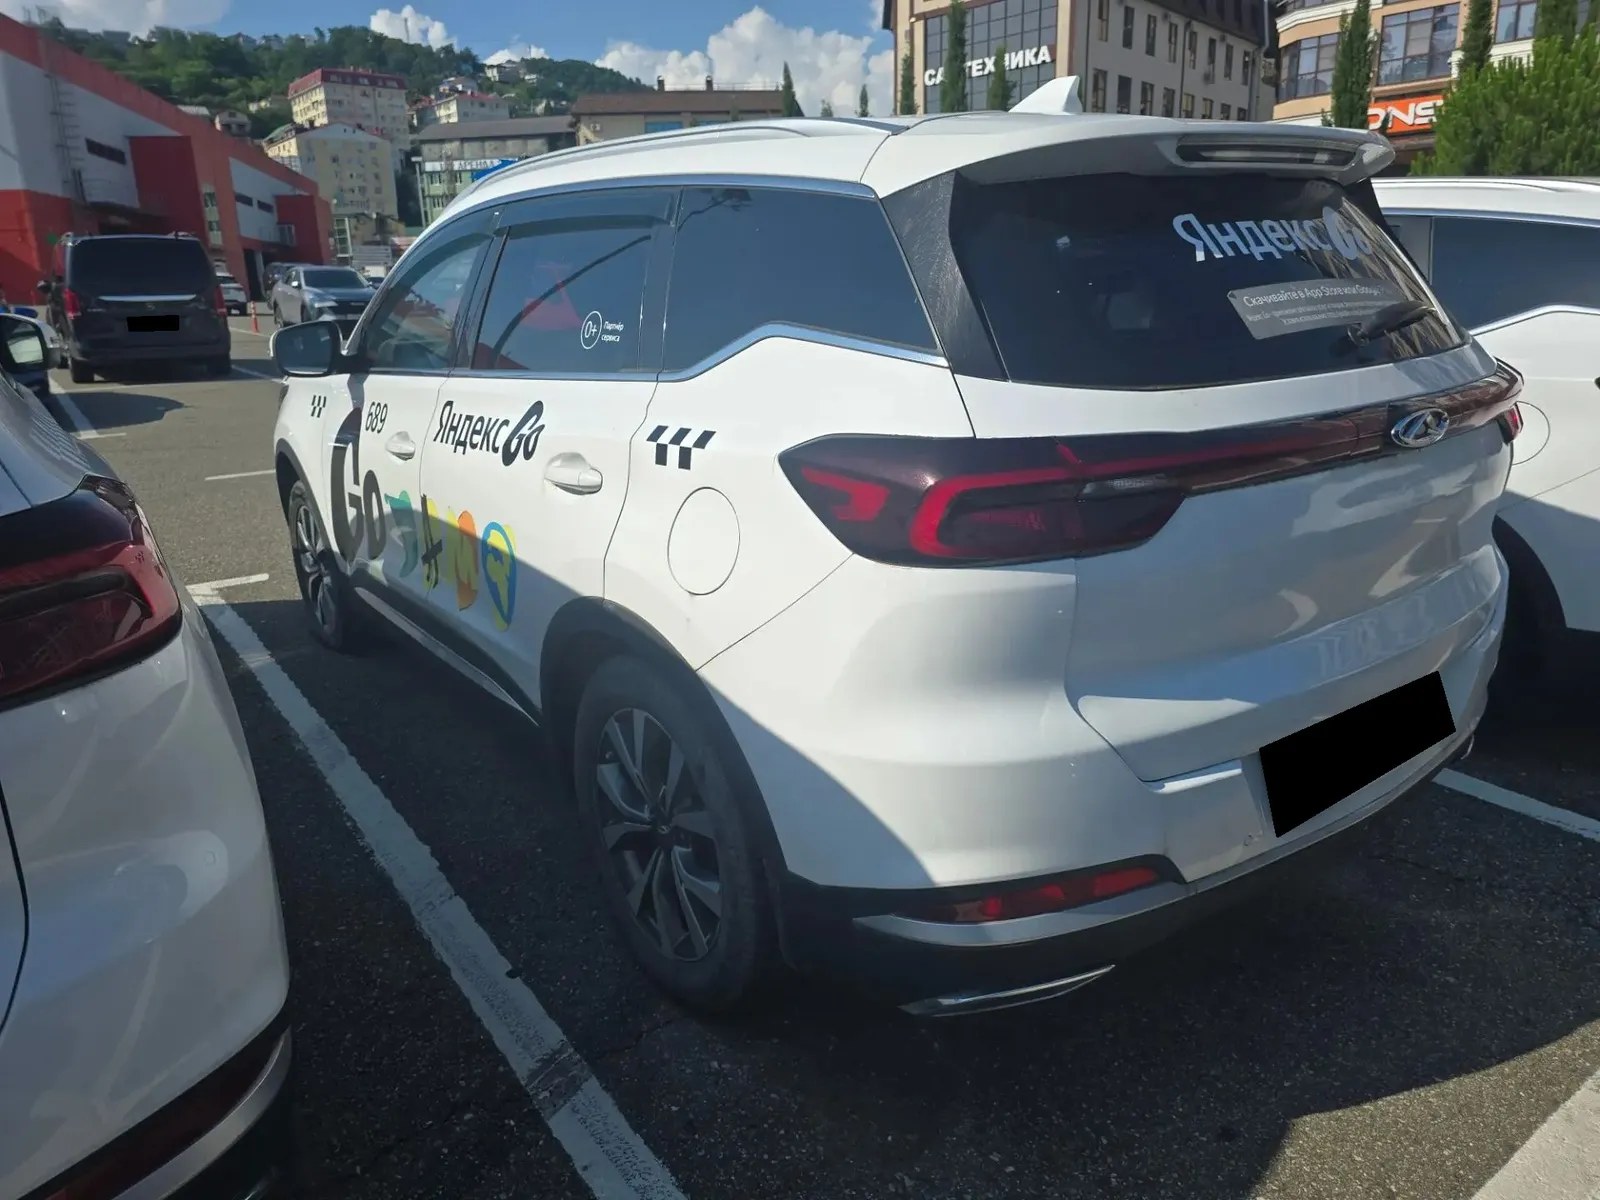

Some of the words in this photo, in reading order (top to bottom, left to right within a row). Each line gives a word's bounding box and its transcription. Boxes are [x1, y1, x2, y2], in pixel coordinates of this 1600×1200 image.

[924, 45, 1051, 86] САТЕХИКА
[1367, 99, 1443, 130] DNS
[1173, 212, 1332, 262] Яндекс
[1243, 290, 1299, 307] Скачивайте
[1297, 290, 1306, 298] в
[1304, 287, 1323, 299] App
[1320, 286, 1344, 297] Store
[365, 401, 388, 433] 689
[433, 400, 510, 455] Яндекс
[502, 400, 545, 466] Go
[331, 407, 386, 563] Go
